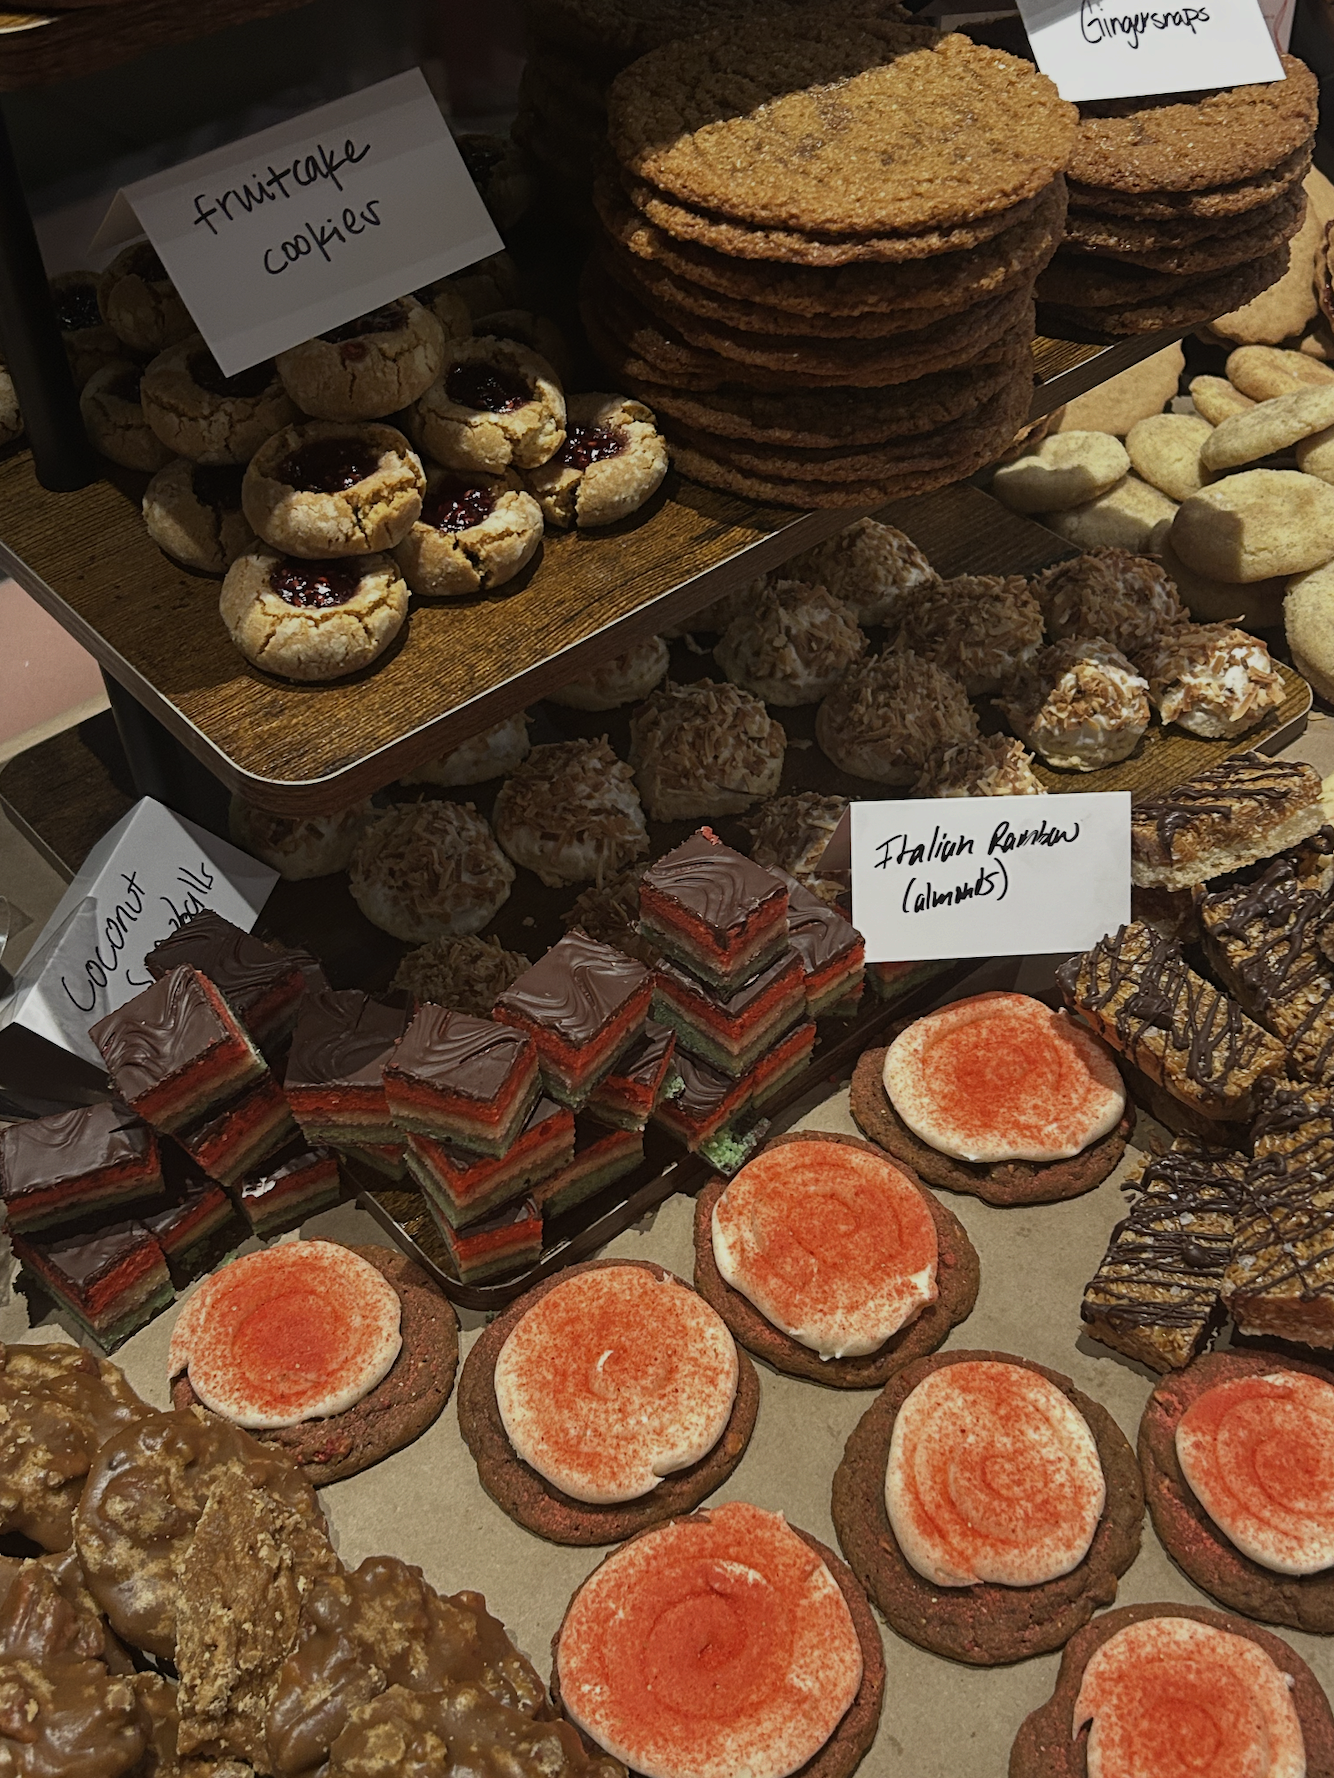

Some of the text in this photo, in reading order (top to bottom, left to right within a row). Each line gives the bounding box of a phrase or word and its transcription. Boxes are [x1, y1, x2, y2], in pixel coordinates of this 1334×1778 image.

[1081, 0, 1210, 49] Gingersnaps
[193, 139, 371, 235] fruitcake
[263, 200, 381, 275] cookies
[874, 825, 974, 869] Italian
[902, 857, 1008, 913] (almonds)
[61, 871, 145, 1012] Coconut
